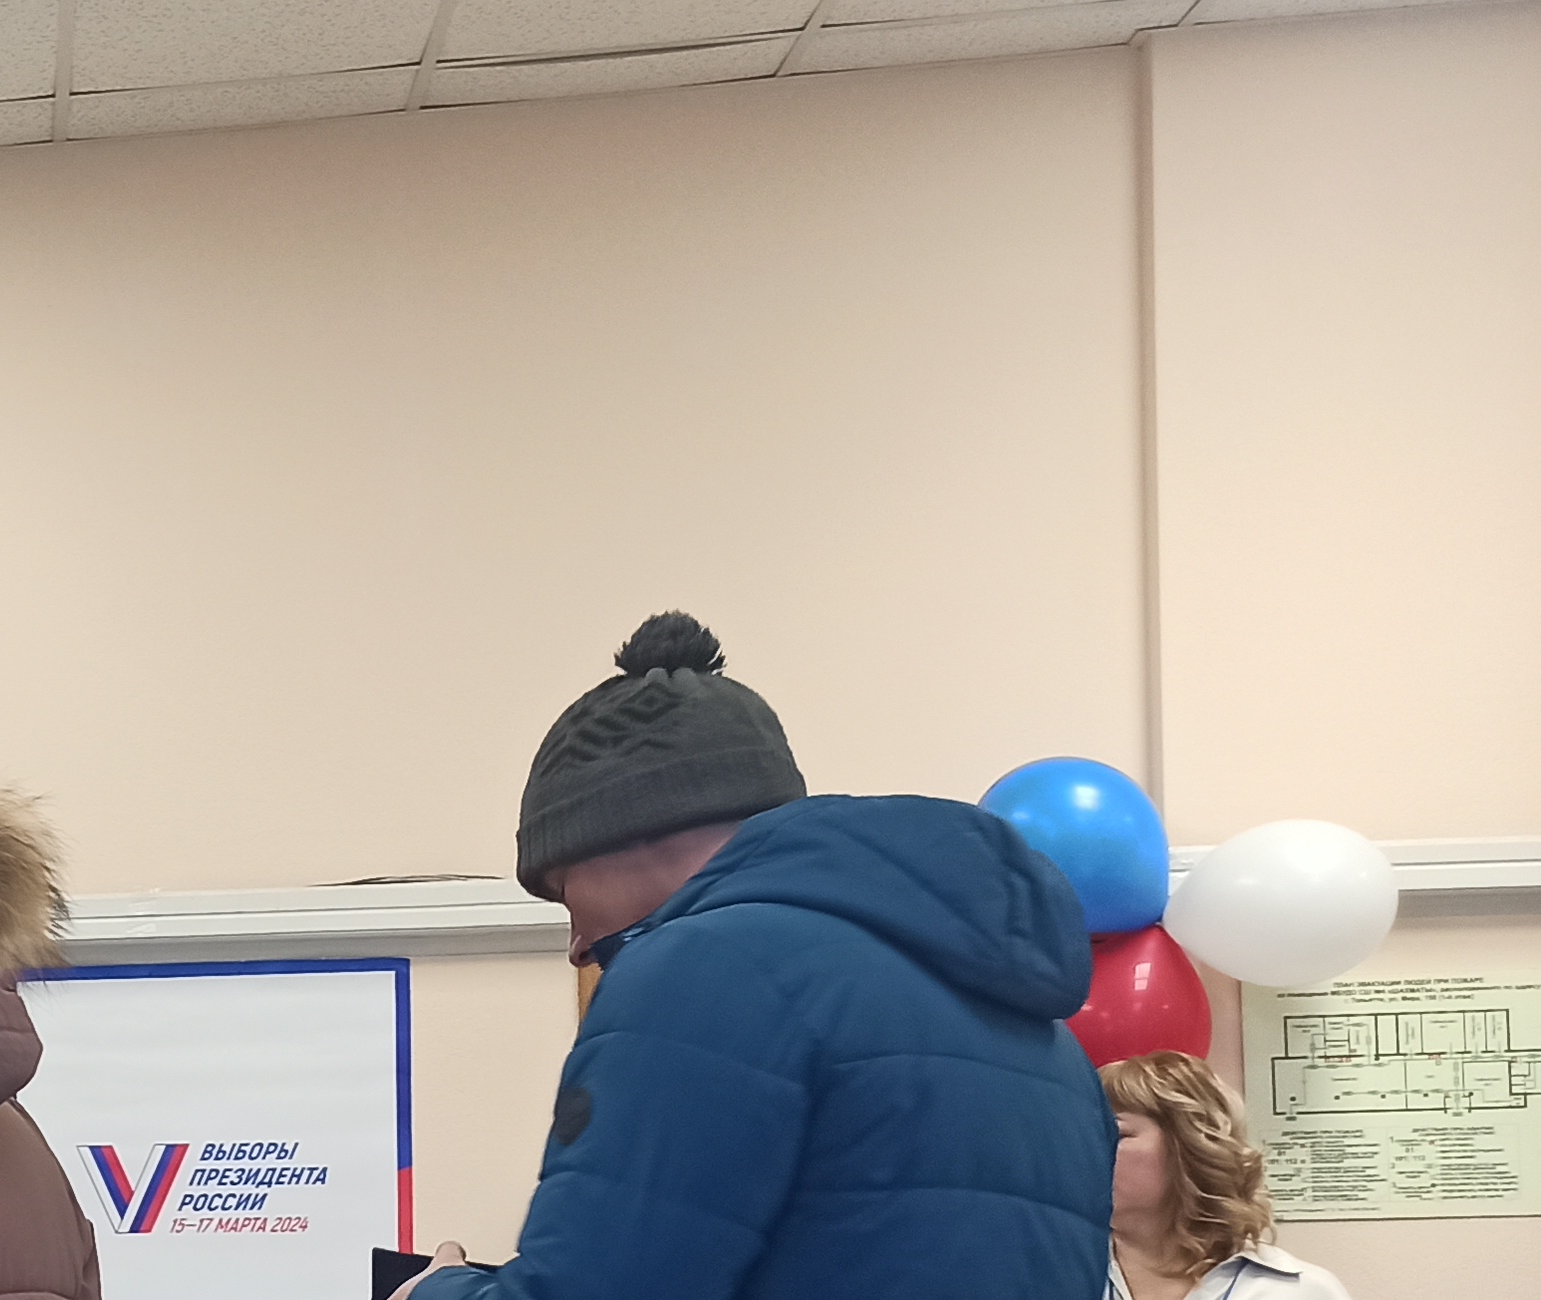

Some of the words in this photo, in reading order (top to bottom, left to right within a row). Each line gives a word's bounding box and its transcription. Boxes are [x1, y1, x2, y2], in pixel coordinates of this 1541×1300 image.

[199, 1142, 299, 1161] ВЫБОРЫ
[188, 1167, 328, 1188] ПРЕЗИДЕНТА
[177, 1193, 268, 1212] РОССИИ
[214, 1217, 268, 1233] МАРТА
[270, 1216, 309, 1233] 2024
